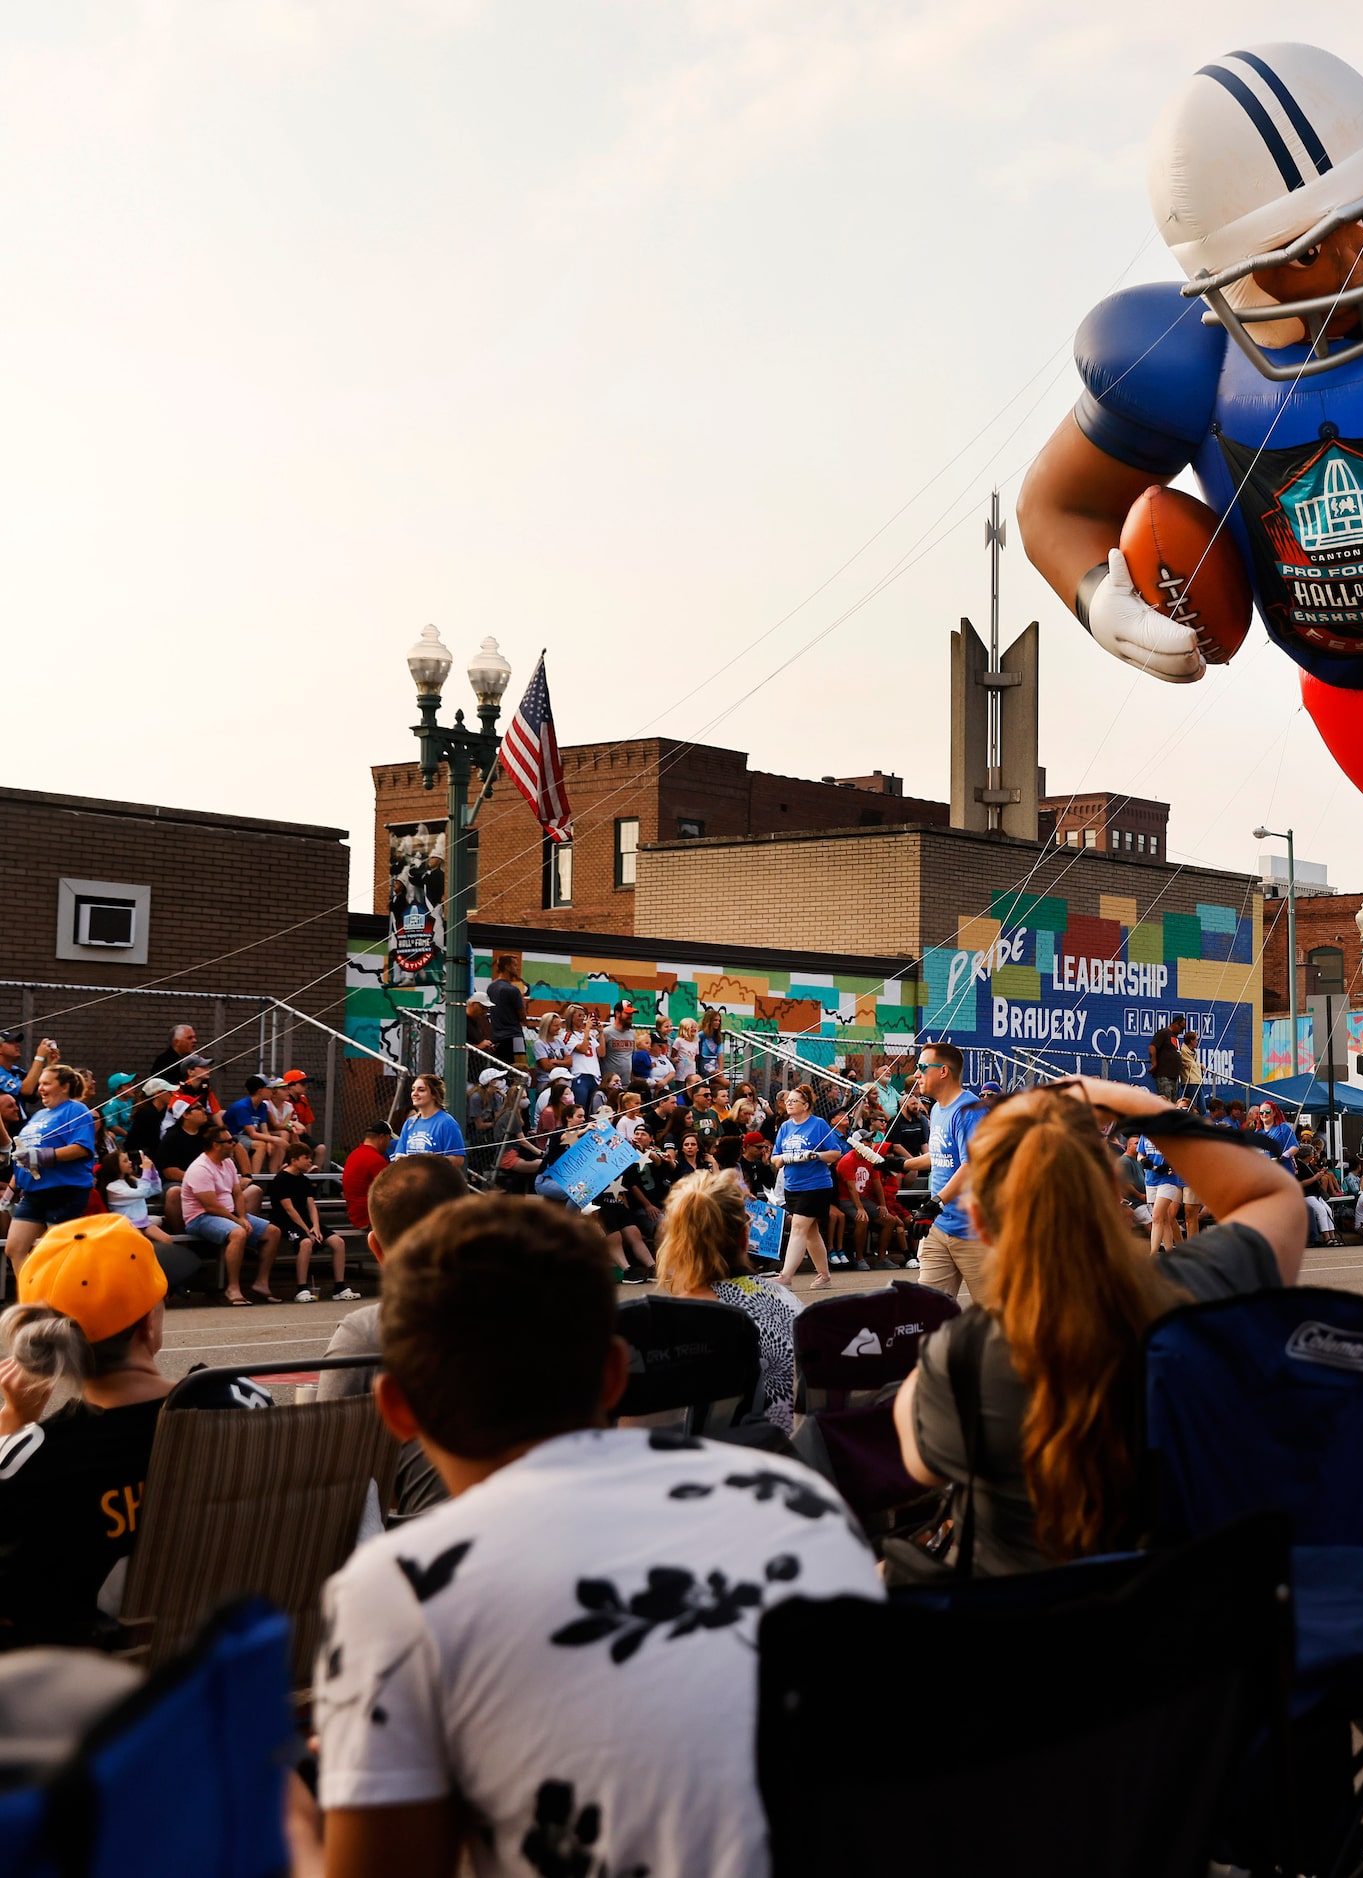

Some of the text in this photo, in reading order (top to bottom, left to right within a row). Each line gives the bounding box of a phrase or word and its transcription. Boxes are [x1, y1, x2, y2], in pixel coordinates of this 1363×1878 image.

[1310, 548, 1361, 563] CANTON
[1282, 565, 1322, 578] PRO
[1293, 581, 1359, 608] HALL
[1053, 954, 1168, 998] LEADERSHIP
[993, 996, 1087, 1041] BRAVERY
